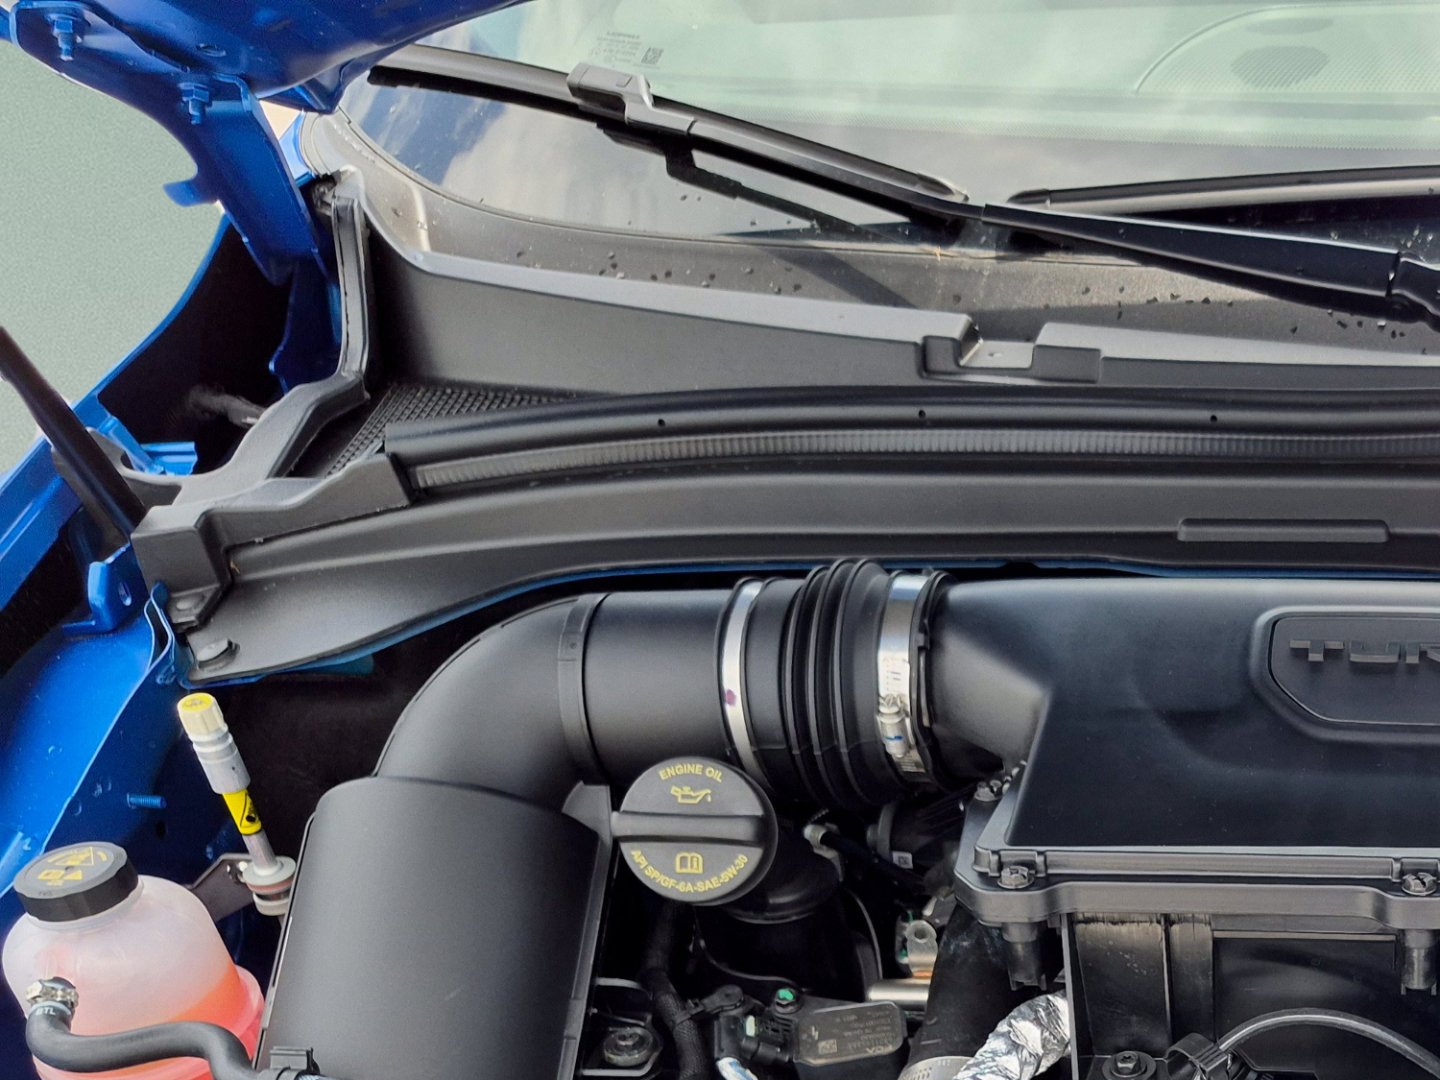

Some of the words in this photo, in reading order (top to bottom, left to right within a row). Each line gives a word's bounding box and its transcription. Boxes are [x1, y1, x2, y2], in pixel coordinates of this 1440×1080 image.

[658, 763, 704, 781] ENGINE
[705, 767, 723, 783] OIL
[630, 849, 648, 870] API
